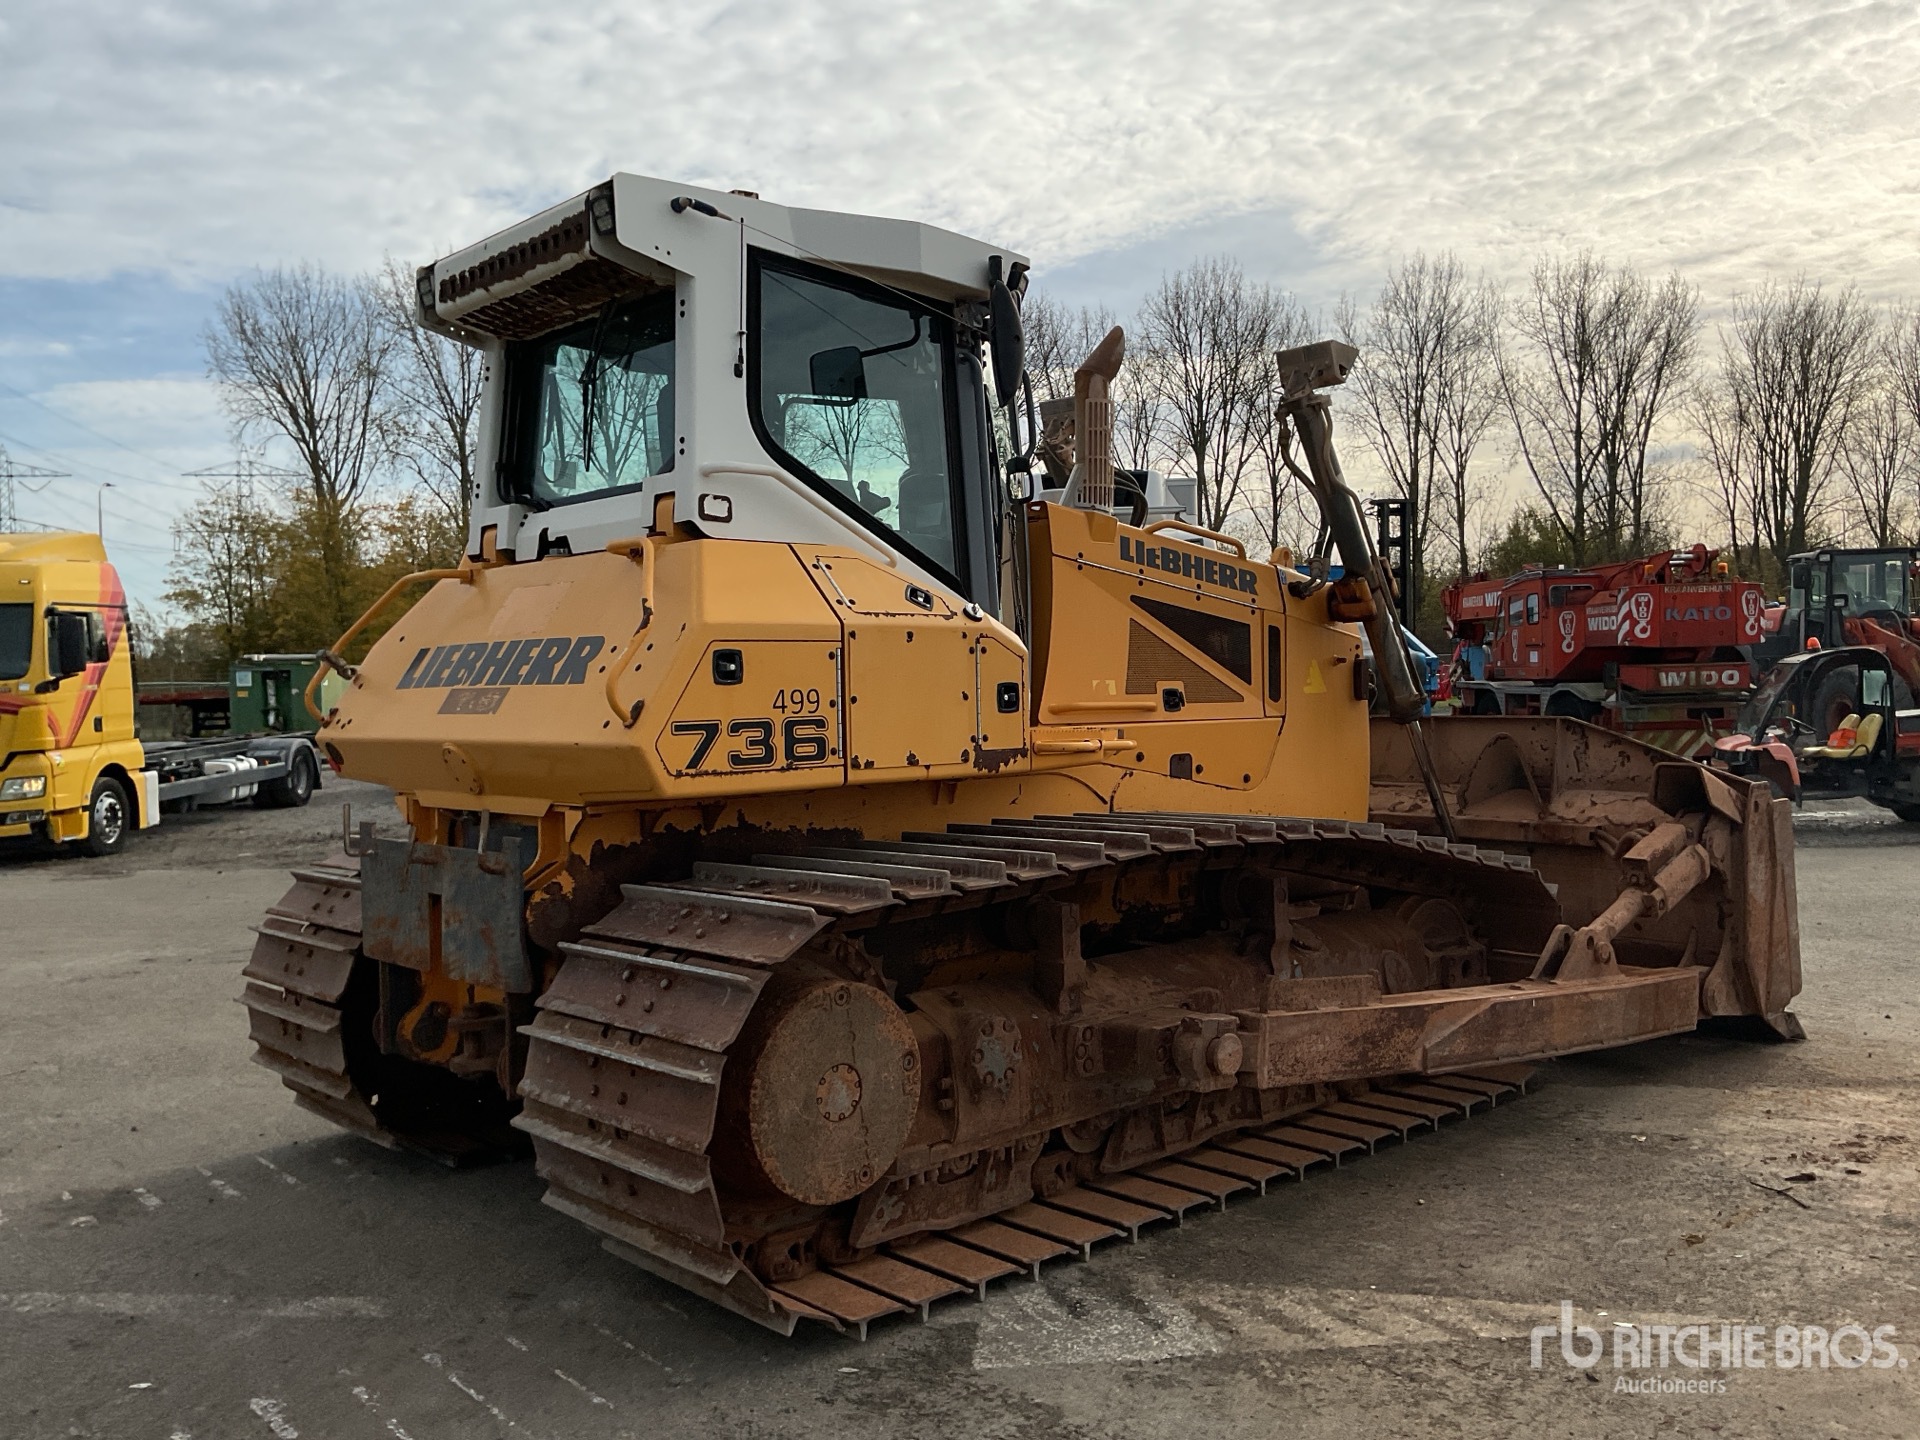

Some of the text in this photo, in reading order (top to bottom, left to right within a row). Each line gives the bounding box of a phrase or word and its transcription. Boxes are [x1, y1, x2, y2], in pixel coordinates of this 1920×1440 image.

[1119, 535, 1258, 596] LIEBHERR
[1664, 584, 1732, 594] KRAANVERHUUR
[1587, 615, 1617, 631] WIDO
[1665, 605, 1732, 621] KATO
[396, 635, 606, 690] LIEBHERR
[1658, 669, 1740, 687] WIDO
[772, 688, 820, 714] 499
[671, 715, 829, 770] 736
